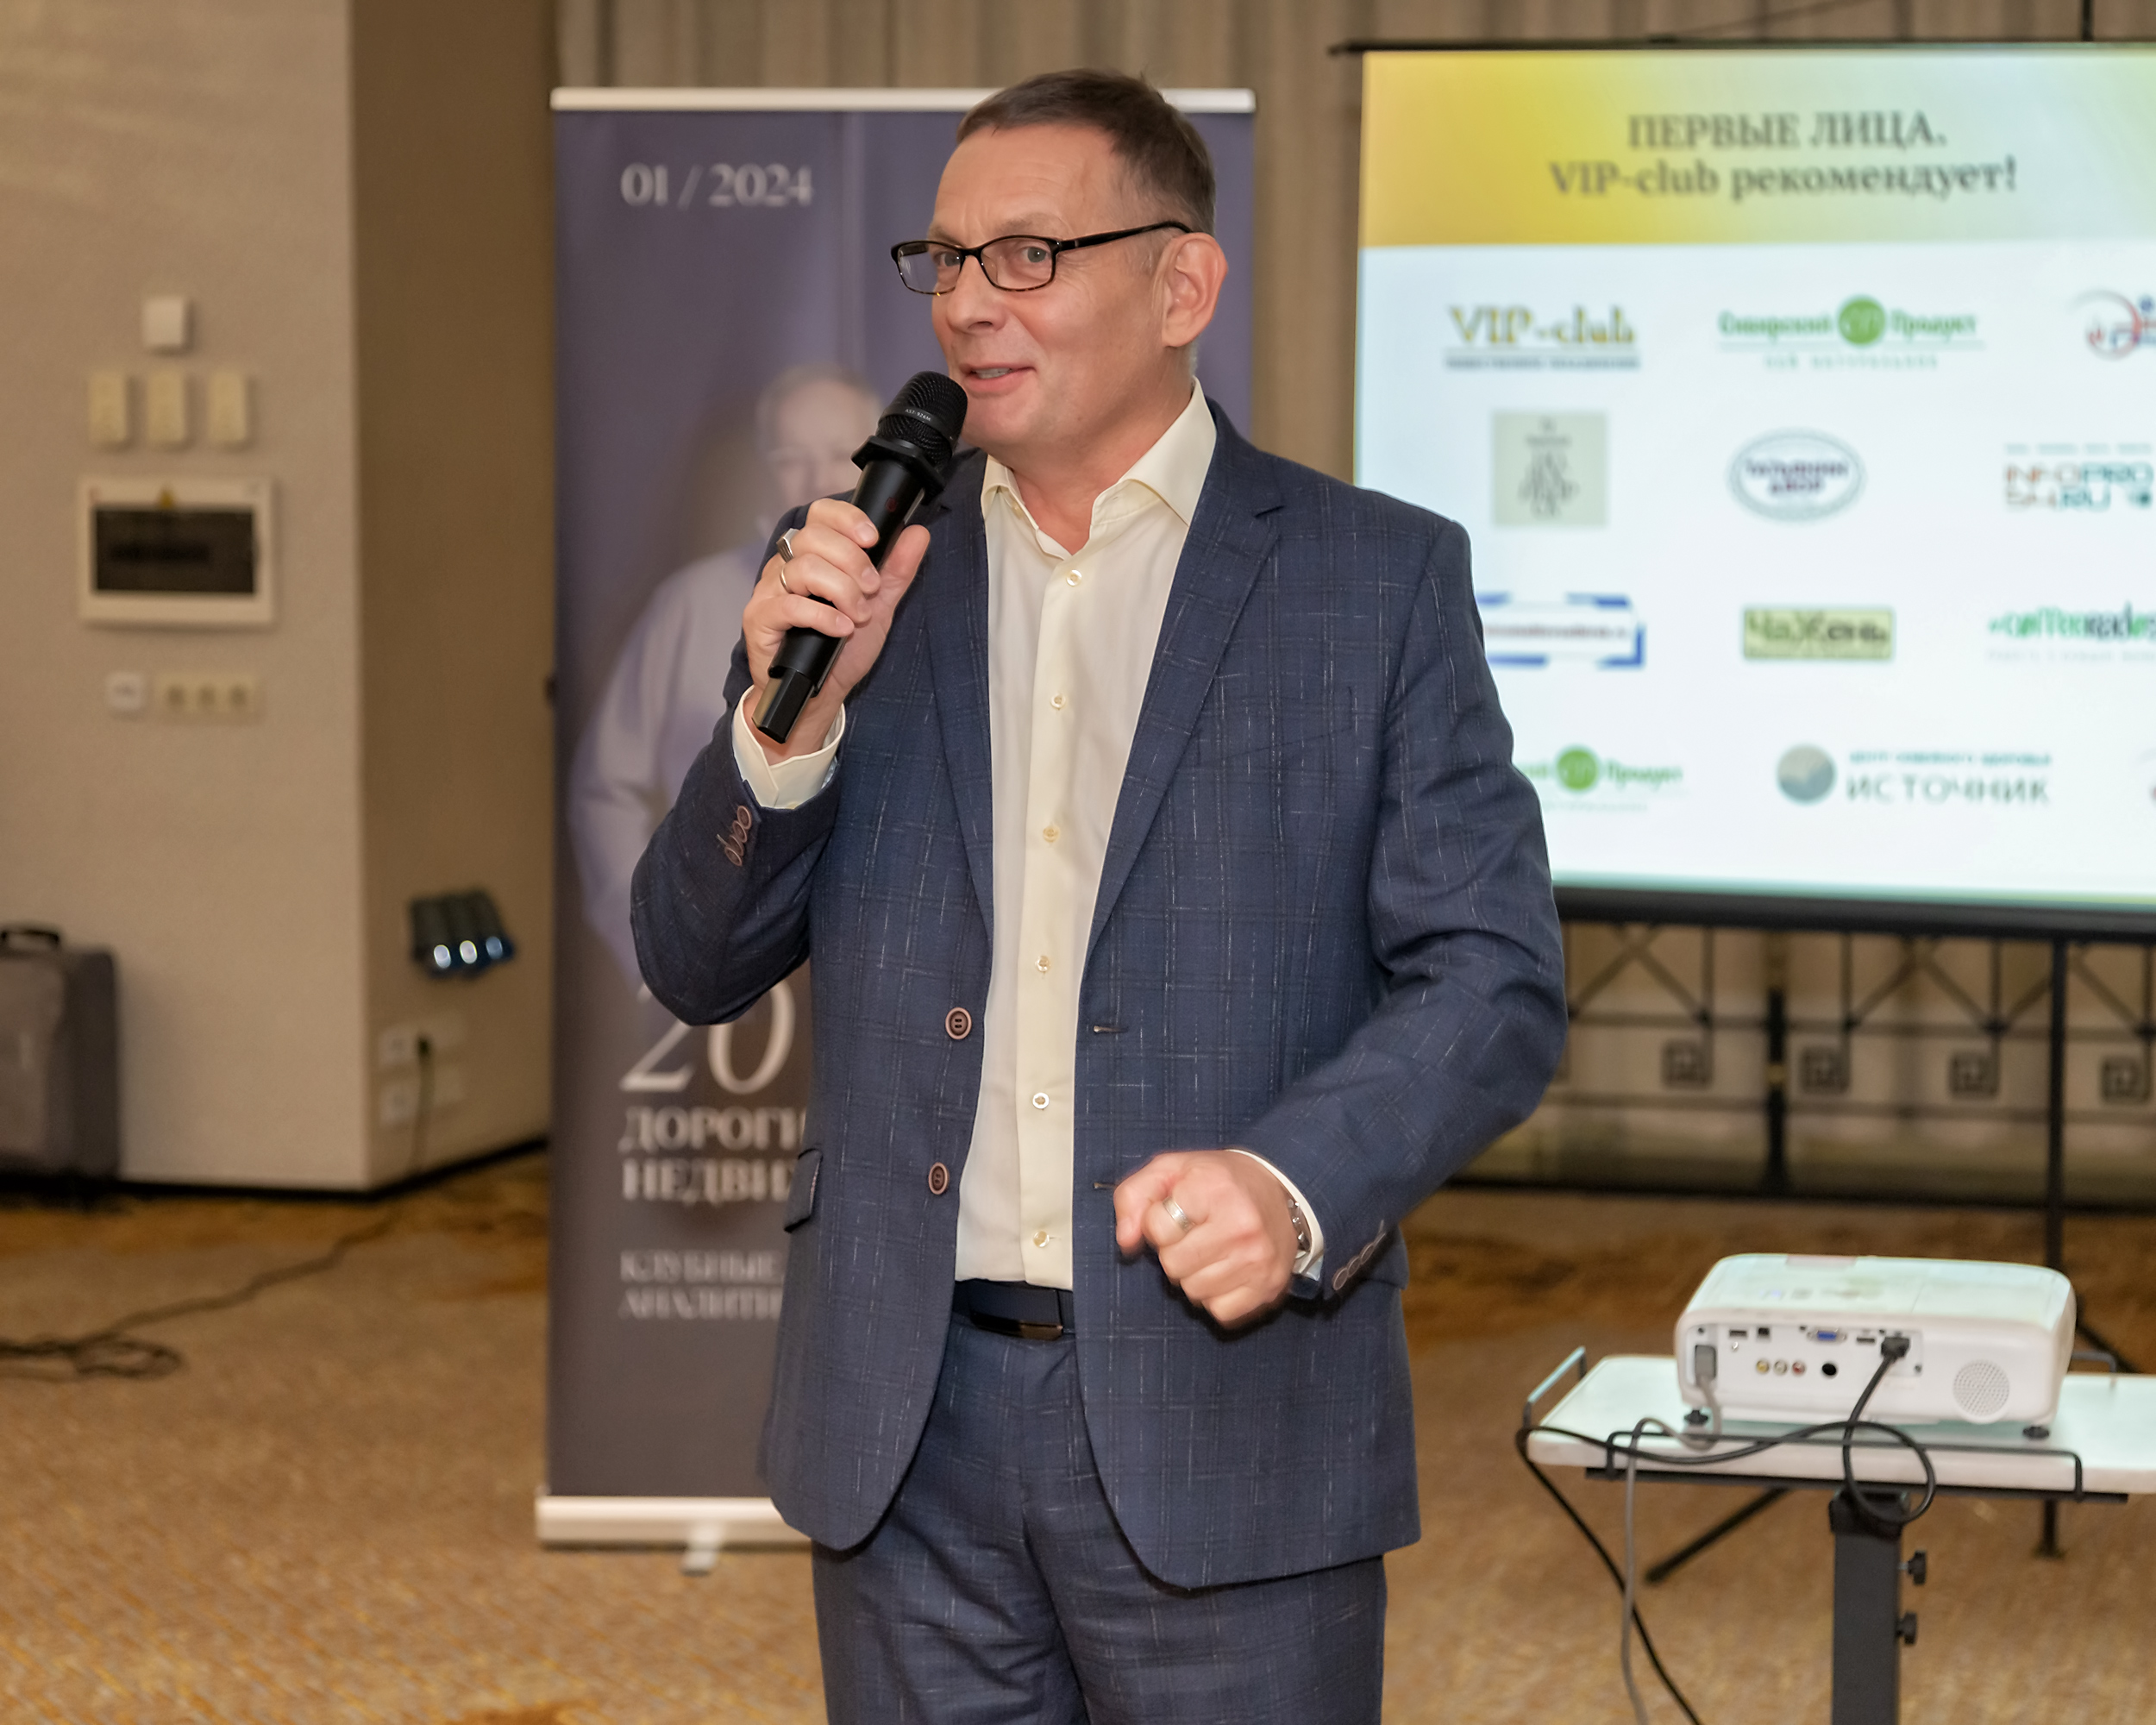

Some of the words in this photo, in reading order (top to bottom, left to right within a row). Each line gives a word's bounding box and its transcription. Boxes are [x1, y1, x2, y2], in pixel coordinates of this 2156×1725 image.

[1626, 113, 1802, 150] ПЕРВЫЕ
[1810, 110, 1948, 151] ЛИЦА.
[620, 162, 668, 207] 01
[708, 163, 813, 208] 2024
[1548, 159, 1720, 198] VIP-club
[1730, 154, 2017, 204] рекомендует!
[1449, 304, 1636, 347] VIP-club
[1846, 773, 2051, 806] ИСТОЧНИК
